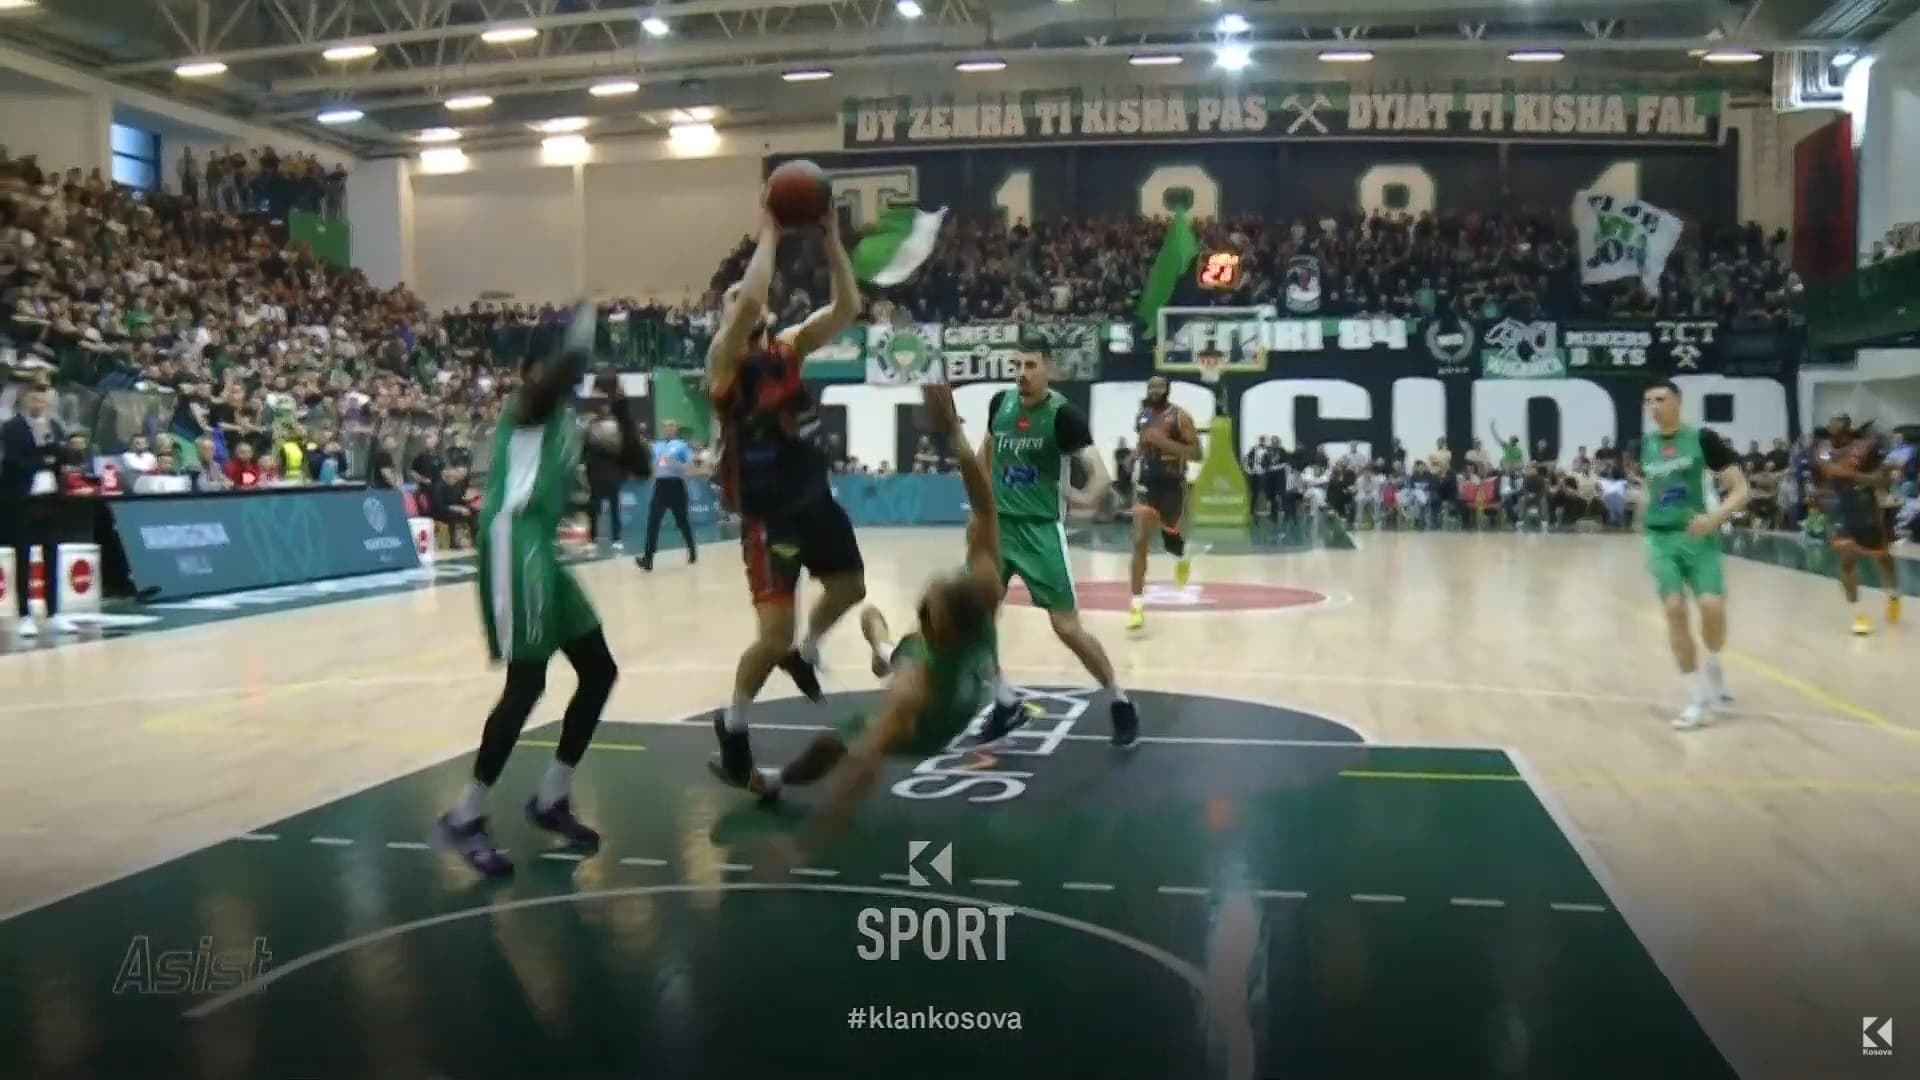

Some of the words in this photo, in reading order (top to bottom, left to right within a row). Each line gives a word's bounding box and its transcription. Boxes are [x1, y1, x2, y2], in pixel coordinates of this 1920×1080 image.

[856, 109, 898, 142] DY
[1035, 96, 1073, 135] TI
[1197, 95, 1268, 132] PAS
[1464, 93, 1504, 131] TI
[1513, 94, 1627, 133] KISHA
[1635, 95, 1706, 134] FAL
[1655, 321, 1718, 343] TCT
